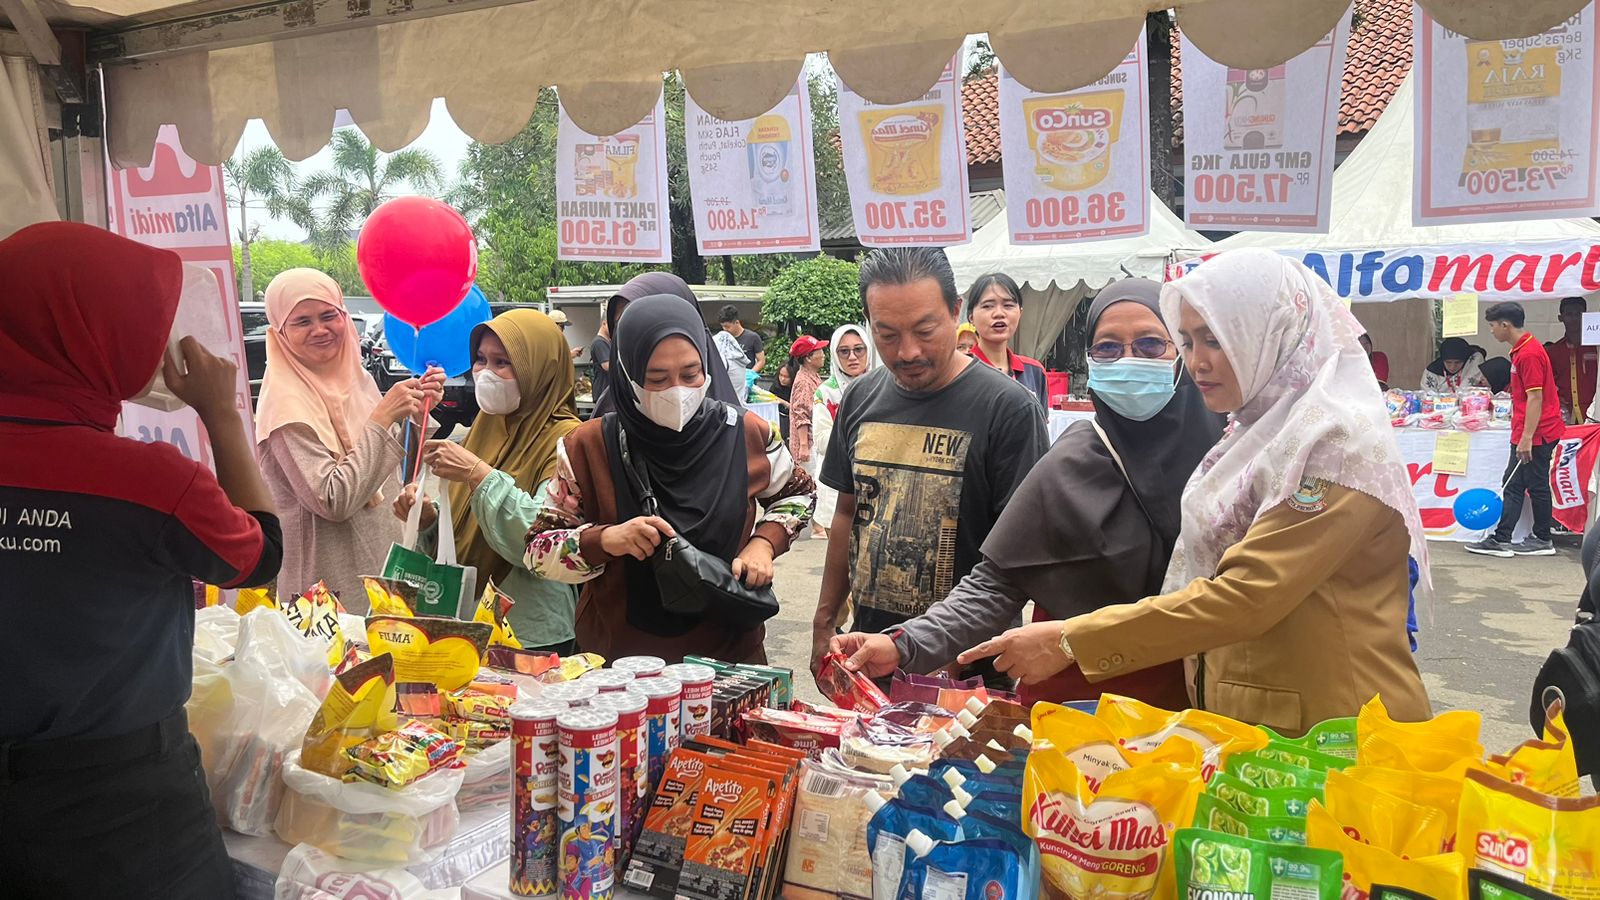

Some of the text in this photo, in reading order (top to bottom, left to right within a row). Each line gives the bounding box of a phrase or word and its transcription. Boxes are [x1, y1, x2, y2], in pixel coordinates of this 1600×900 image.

[922, 433, 964, 457] NEW
[17, 508, 73, 529] ANDA
[378, 631, 412, 644] FILMA
[670, 755, 704, 772] Apetito
[1083, 753, 1110, 768] Minyak
[704, 777, 743, 794] Apetito
[1029, 791, 1168, 851] Kunci Mas
[1039, 842, 1078, 863] Kuncinya
[1477, 834, 1527, 865] SunCo
[1480, 882, 1504, 896] LION
